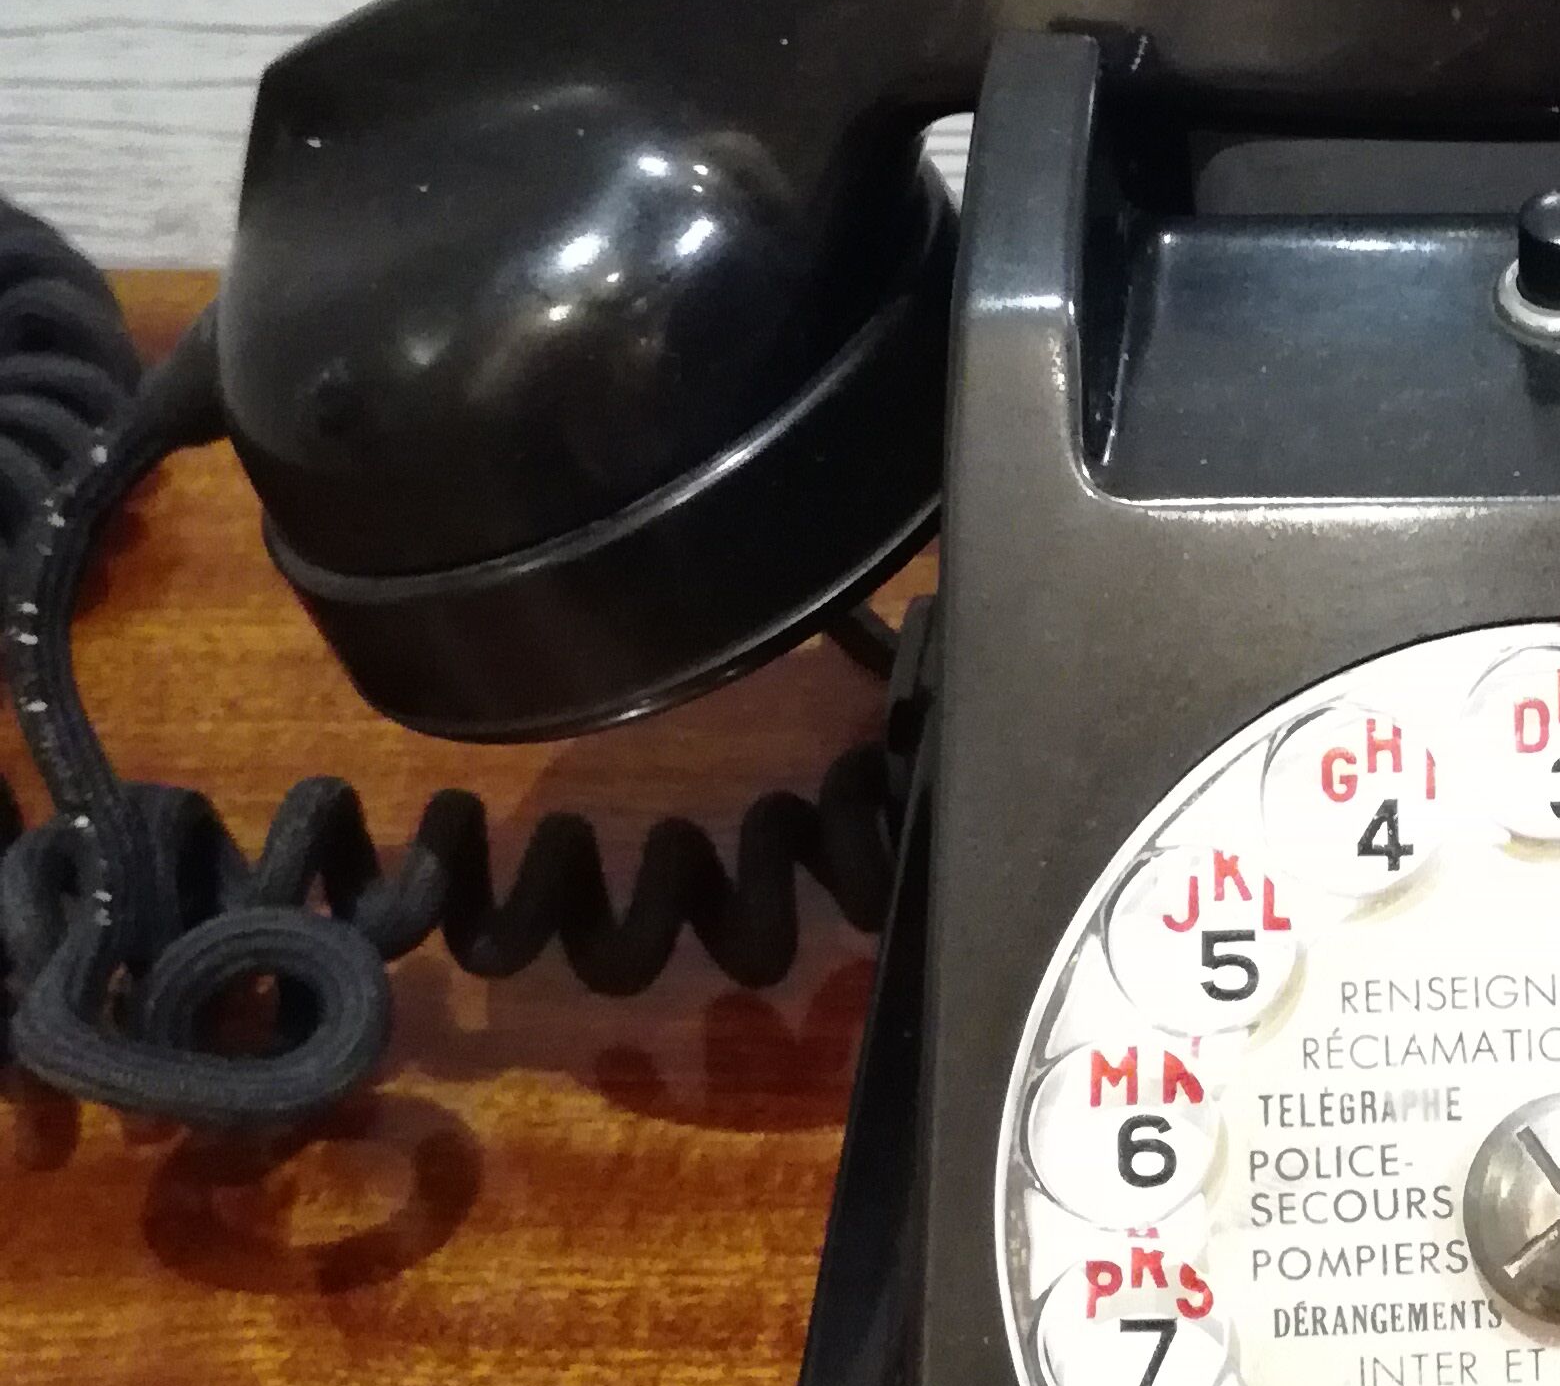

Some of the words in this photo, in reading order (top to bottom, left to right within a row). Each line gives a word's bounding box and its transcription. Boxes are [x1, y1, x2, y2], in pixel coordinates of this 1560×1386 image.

[1320, 717, 1437, 803] GHI
[1356, 798, 1414, 872] 4
[1162, 850, 1292, 933] JKL
[1199, 929, 1260, 1002] 5
[1116, 1114, 1178, 1189] 6
[1249, 1184, 1454, 1229] SECOURS
[1252, 1238, 1470, 1283] POMPIERS
[1273, 1298, 1503, 1340] DÉRANGEMENTS
[1505, 1346, 1547, 1384] ET
